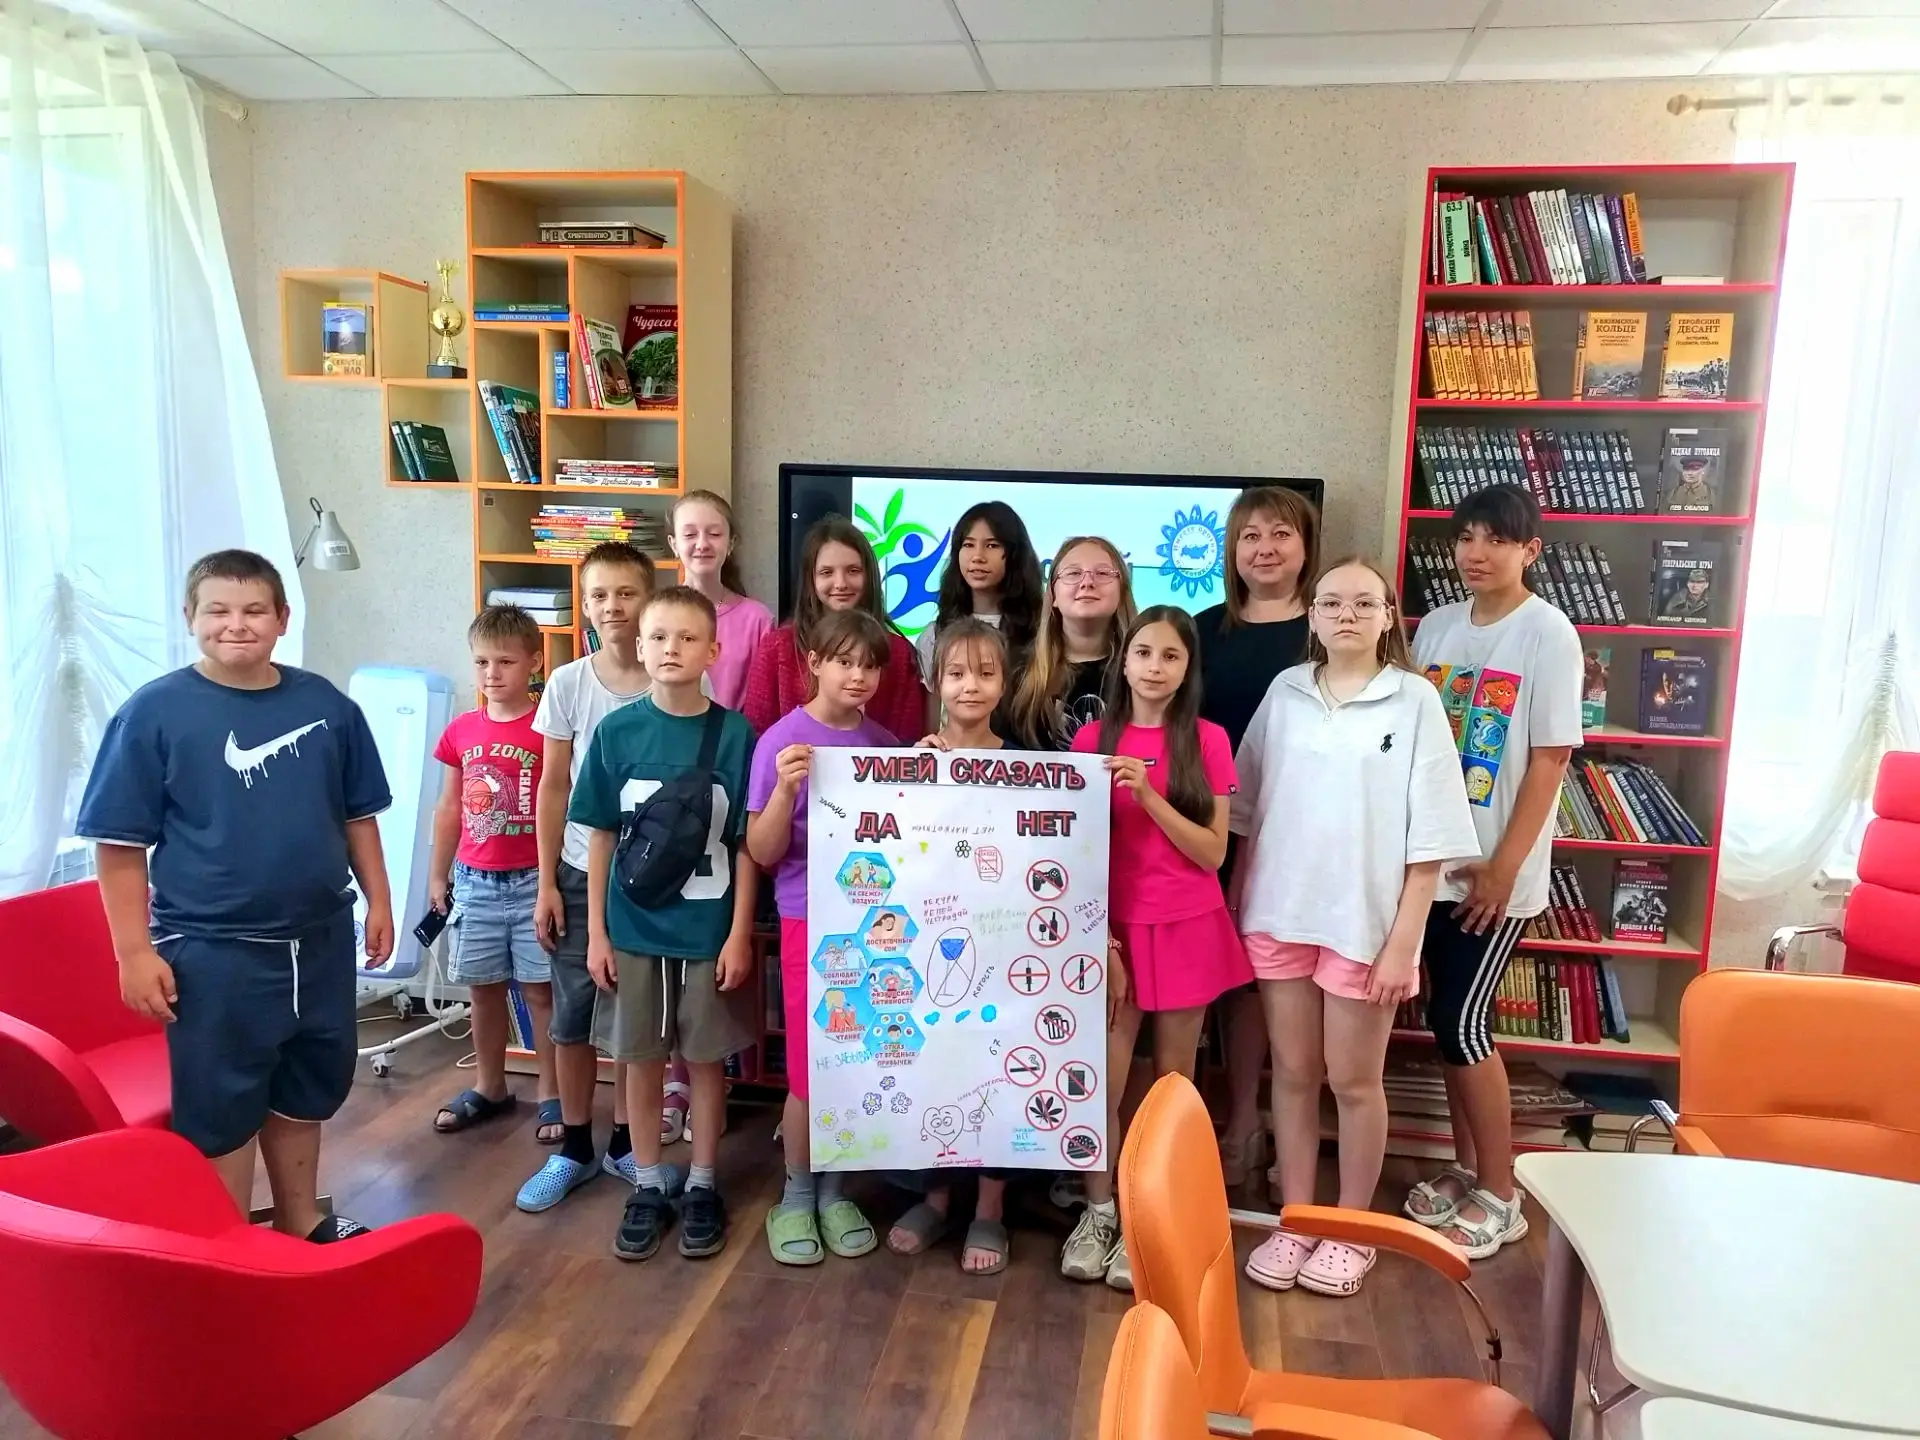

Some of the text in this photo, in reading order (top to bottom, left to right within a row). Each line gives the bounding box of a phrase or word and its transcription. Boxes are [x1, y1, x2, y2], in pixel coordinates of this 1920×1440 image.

[1446, 201, 1463, 213] 63.3
[633, 315, 672, 330] Чудеса
[1595, 325, 1637, 333] КОЛЬЦЕ
[1677, 325, 1721, 334] ДЕСАНТ
[489, 743, 539, 769] ZONE
[851, 752, 1086, 790] УМЕЙ СКАЗАТЬ
[518, 768, 532, 815] CHAMP
[855, 811, 902, 843] ДА
[1016, 811, 1077, 837] НЕТ
